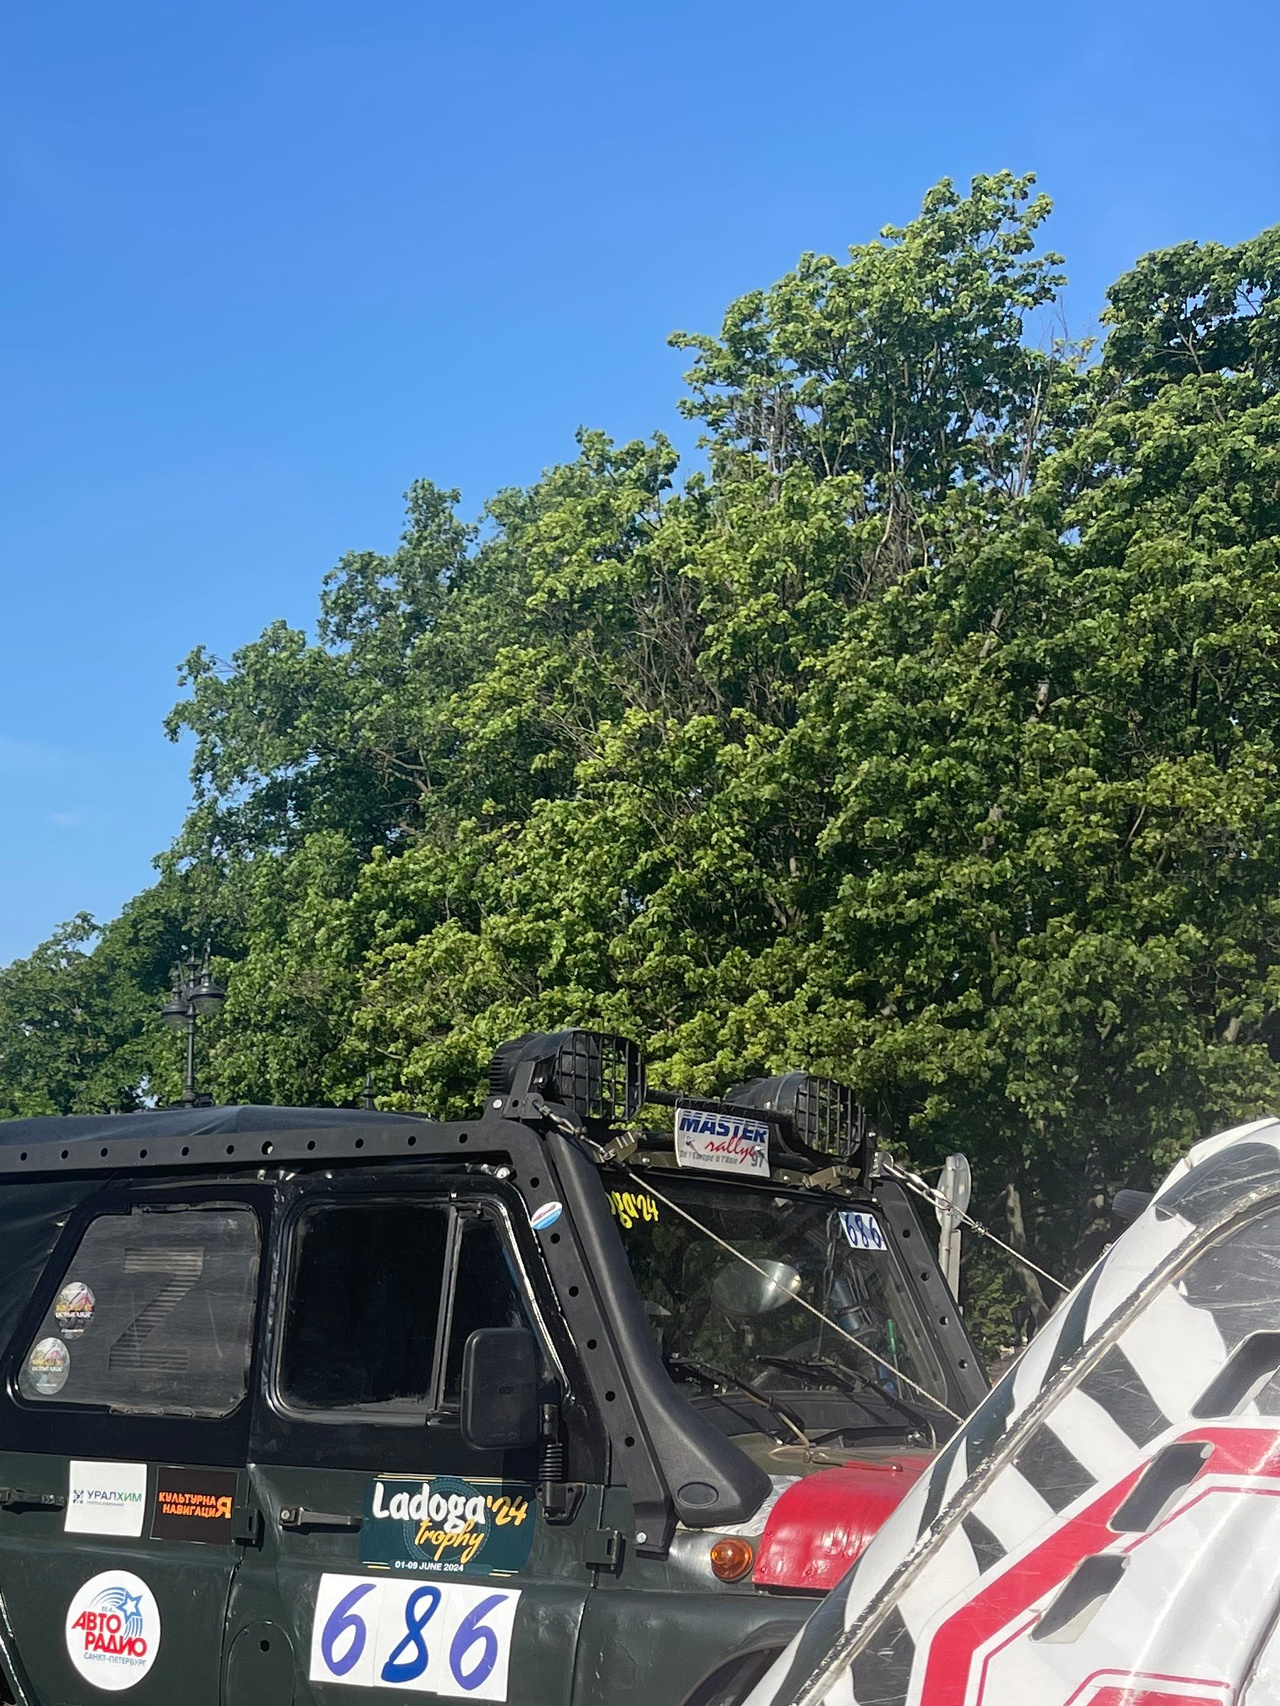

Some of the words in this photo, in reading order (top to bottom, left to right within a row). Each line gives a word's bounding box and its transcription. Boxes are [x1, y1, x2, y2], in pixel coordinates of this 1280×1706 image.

[679, 1110, 769, 1143] MASTER
[704, 1136, 757, 1164] rallye
[845, 1213, 882, 1249] 686
[87, 1490, 143, 1503] УРАЛХИМ
[394, 1560, 418, 1570] 01-09
[419, 1562, 442, 1571] JUNE
[443, 1563, 464, 1572] 2024
[71, 1611, 122, 1634] АВТО
[84, 1631, 148, 1658] РАДИО
[321, 1583, 510, 1691] 686
[84, 1652, 147, 1667] САНКТ-ПЕТЕРБУРГ
